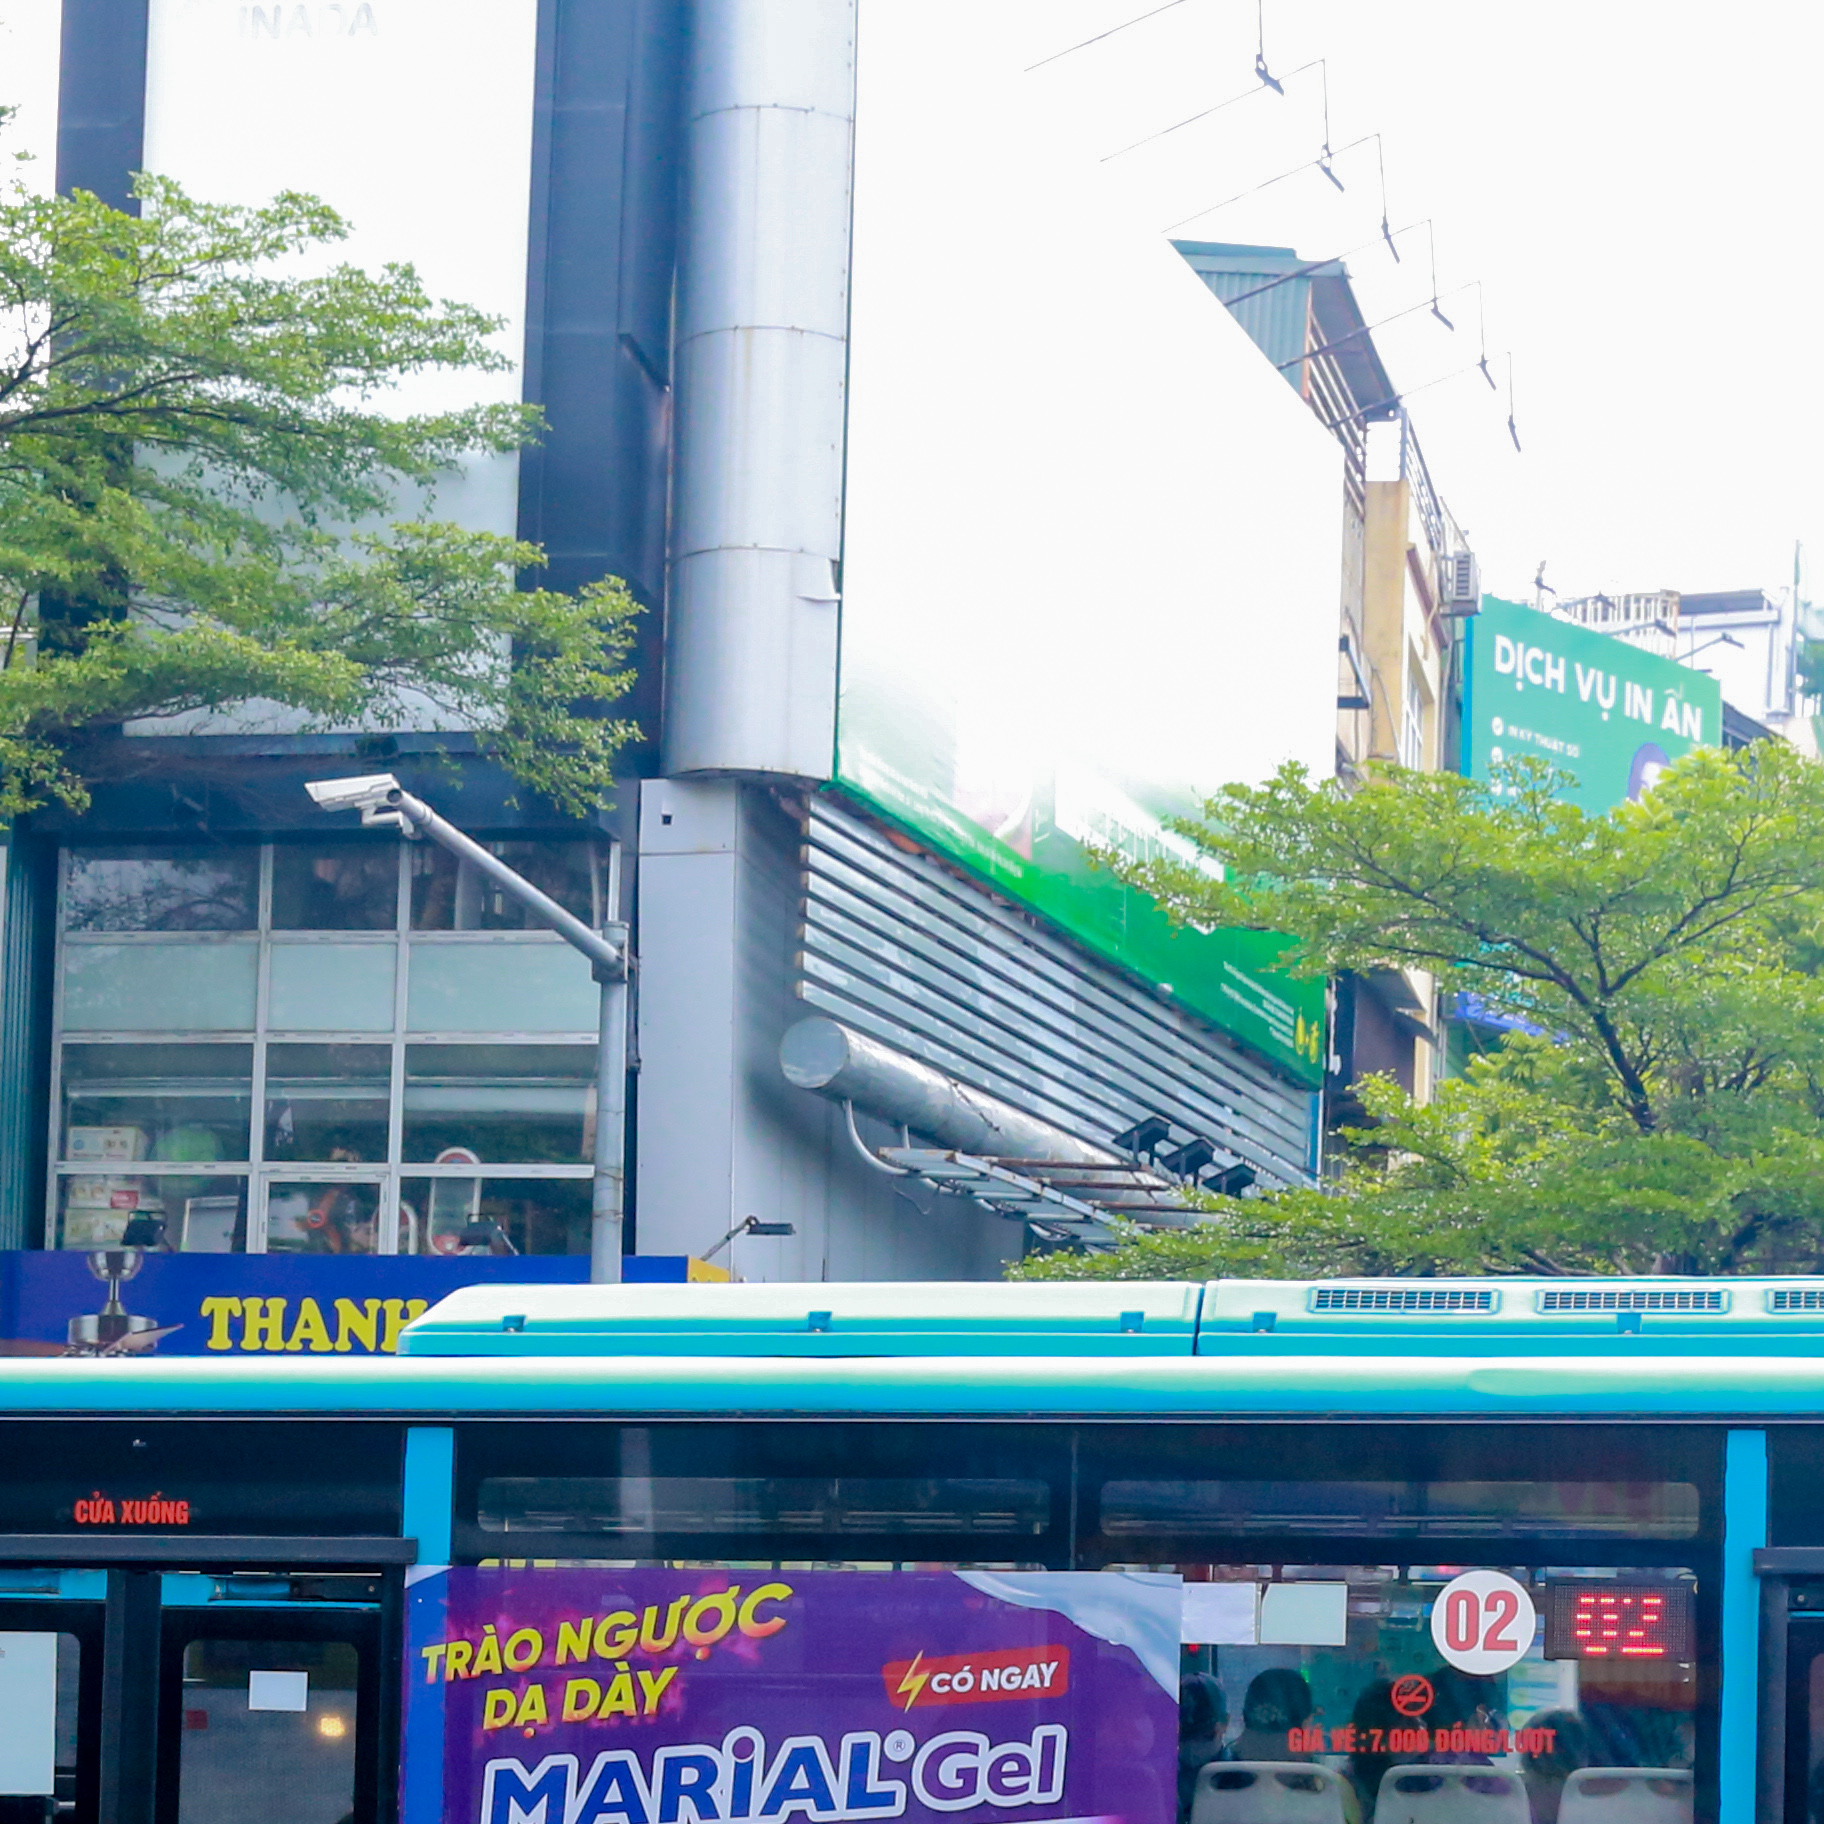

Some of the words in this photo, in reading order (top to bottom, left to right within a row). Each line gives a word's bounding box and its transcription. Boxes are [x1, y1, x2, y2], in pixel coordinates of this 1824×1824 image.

[1494, 634, 1565, 692] DỊCH
[1575, 662, 1617, 721] VỤ
[1624, 681, 1653, 725] IN
[1660, 682, 1702, 742] ẤN
[201, 1296, 428, 1352] THANH
[74, 1491, 115, 1524] CỬA
[120, 1491, 190, 1524] XUỐNG
[421, 1623, 543, 1683] TRÀO
[557, 1582, 795, 1663] NGƯỢC
[1444, 1589, 1519, 1652] 02
[482, 1684, 552, 1738] DẠ
[562, 1664, 679, 1724] DÀY
[930, 1661, 974, 1696] CÓ
[979, 1660, 1060, 1694] NGAY
[1288, 1726, 1324, 1753] GIÁ
